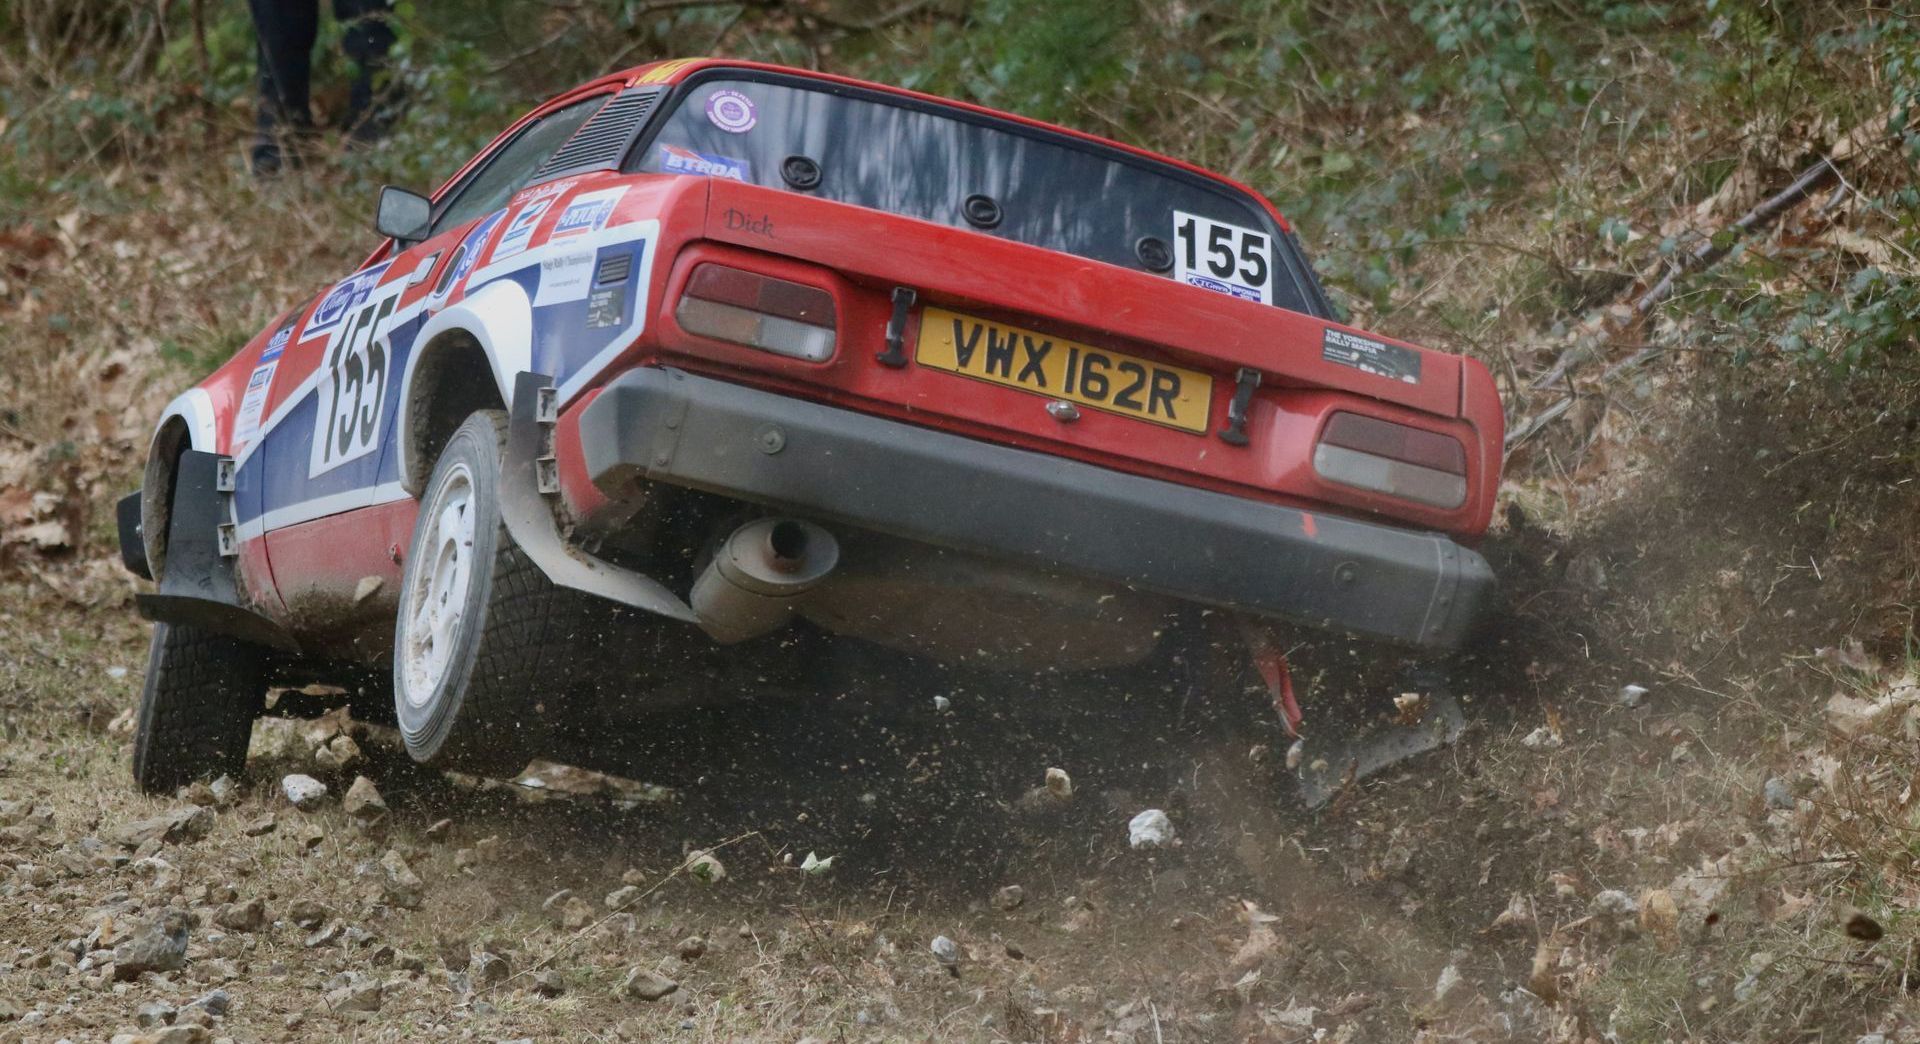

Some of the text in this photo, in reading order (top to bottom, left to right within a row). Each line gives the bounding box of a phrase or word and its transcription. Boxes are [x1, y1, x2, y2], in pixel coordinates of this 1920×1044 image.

[666, 154, 743, 181] BTRDA
[723, 208, 775, 239] Dick
[1178, 218, 1267, 287] 155
[1325, 335, 1350, 347] RALLY
[1326, 328, 1341, 339] THE
[324, 293, 399, 463] 155
[953, 319, 1181, 420] VWX 162R
